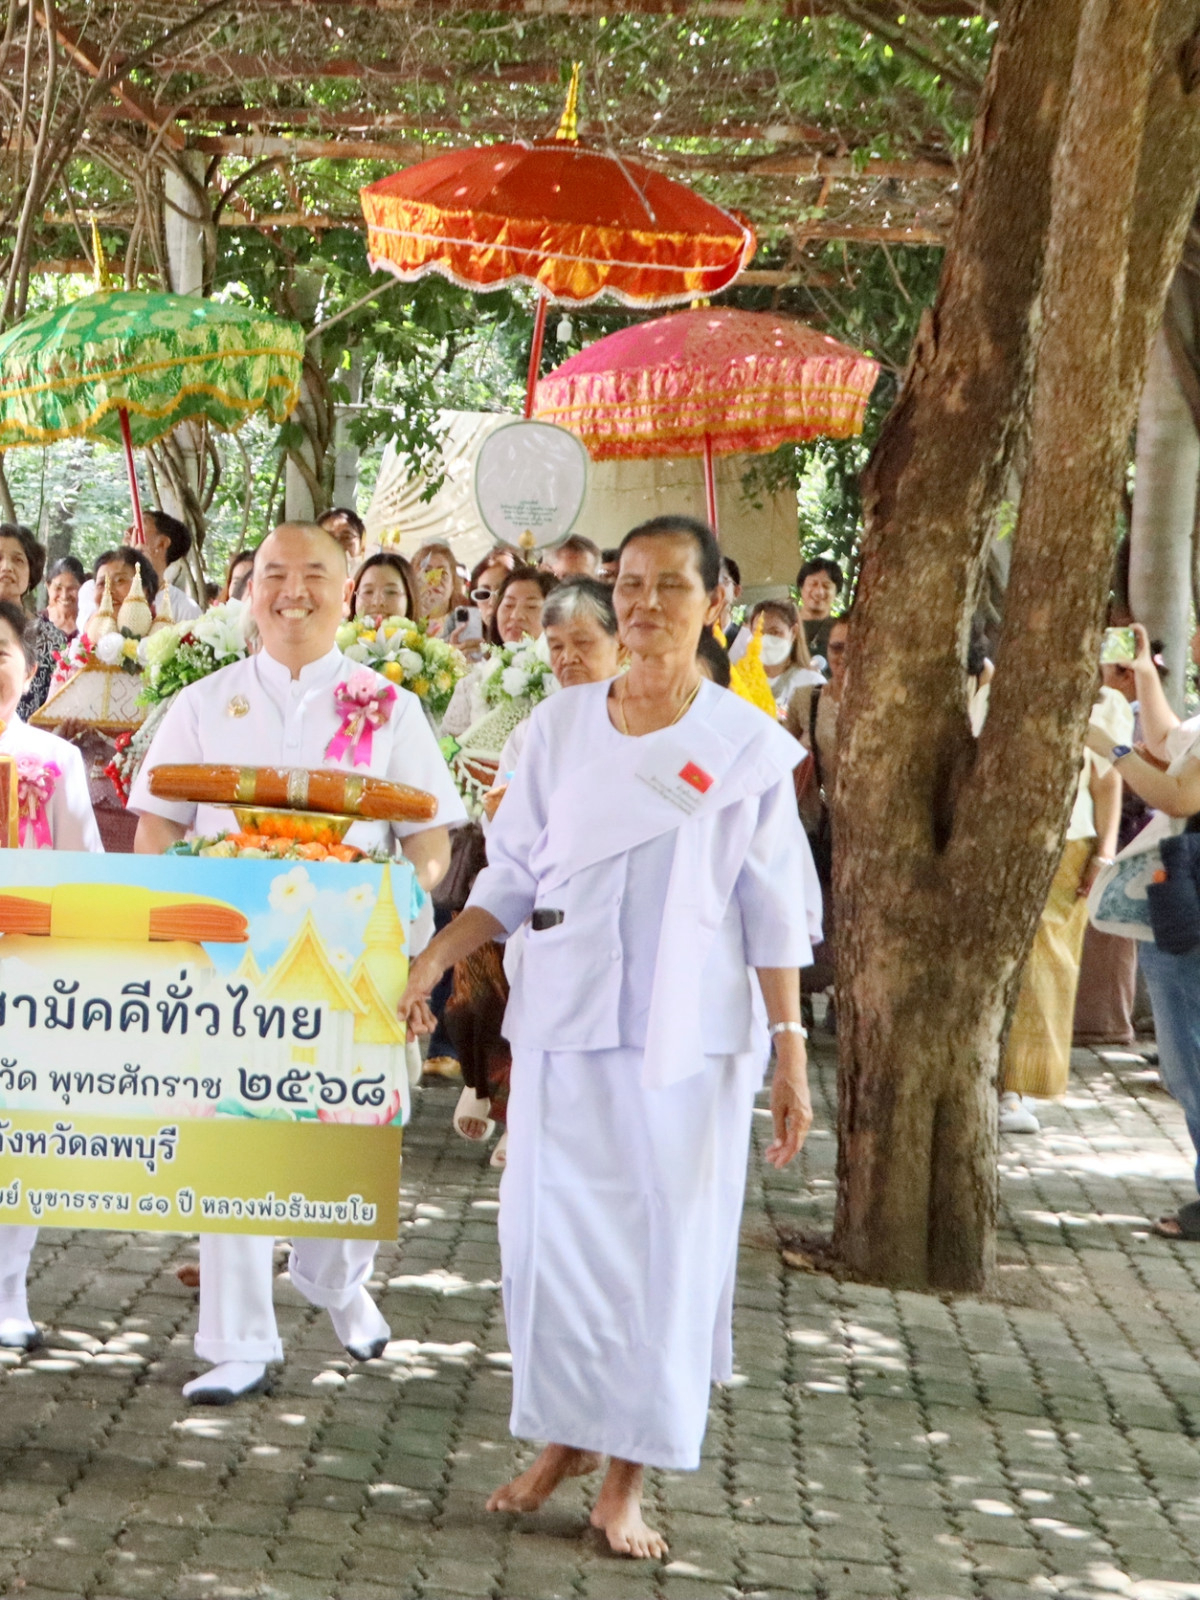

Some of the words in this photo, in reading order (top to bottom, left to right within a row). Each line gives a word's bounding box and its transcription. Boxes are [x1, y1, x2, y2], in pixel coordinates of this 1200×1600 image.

[49, 1063, 222, 1106] พุทธศักราช
[238, 1067, 386, 1107] ๒๕๖๘
[28, 1190, 130, 1215] บูชาธรรม
[138, 1195, 169, 1214] ๘๑
[178, 1189, 193, 1214] ปี
[202, 1191, 374, 1222] หลวงพ่อธัมมชโย
